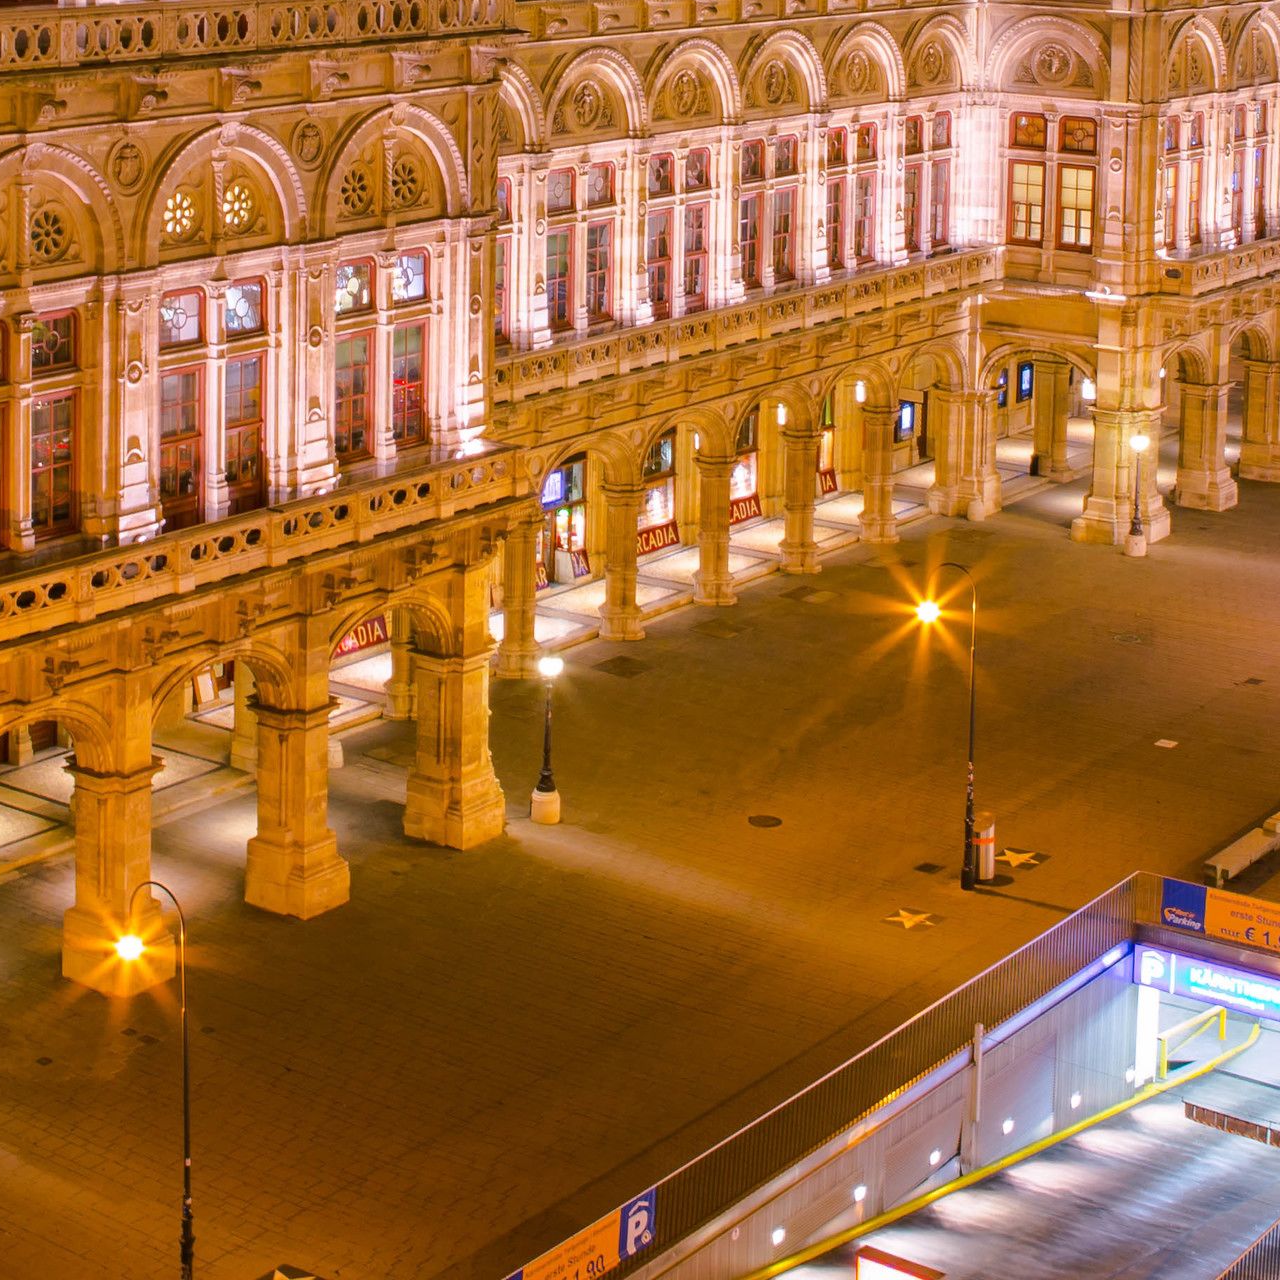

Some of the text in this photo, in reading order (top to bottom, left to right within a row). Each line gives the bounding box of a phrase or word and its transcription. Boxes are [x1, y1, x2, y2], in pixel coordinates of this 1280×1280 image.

[1169, 913, 1202, 931] Parking
[1230, 910, 1254, 922] erste
[1220, 927, 1240, 938] nur
[1245, 927, 1256, 942] €
